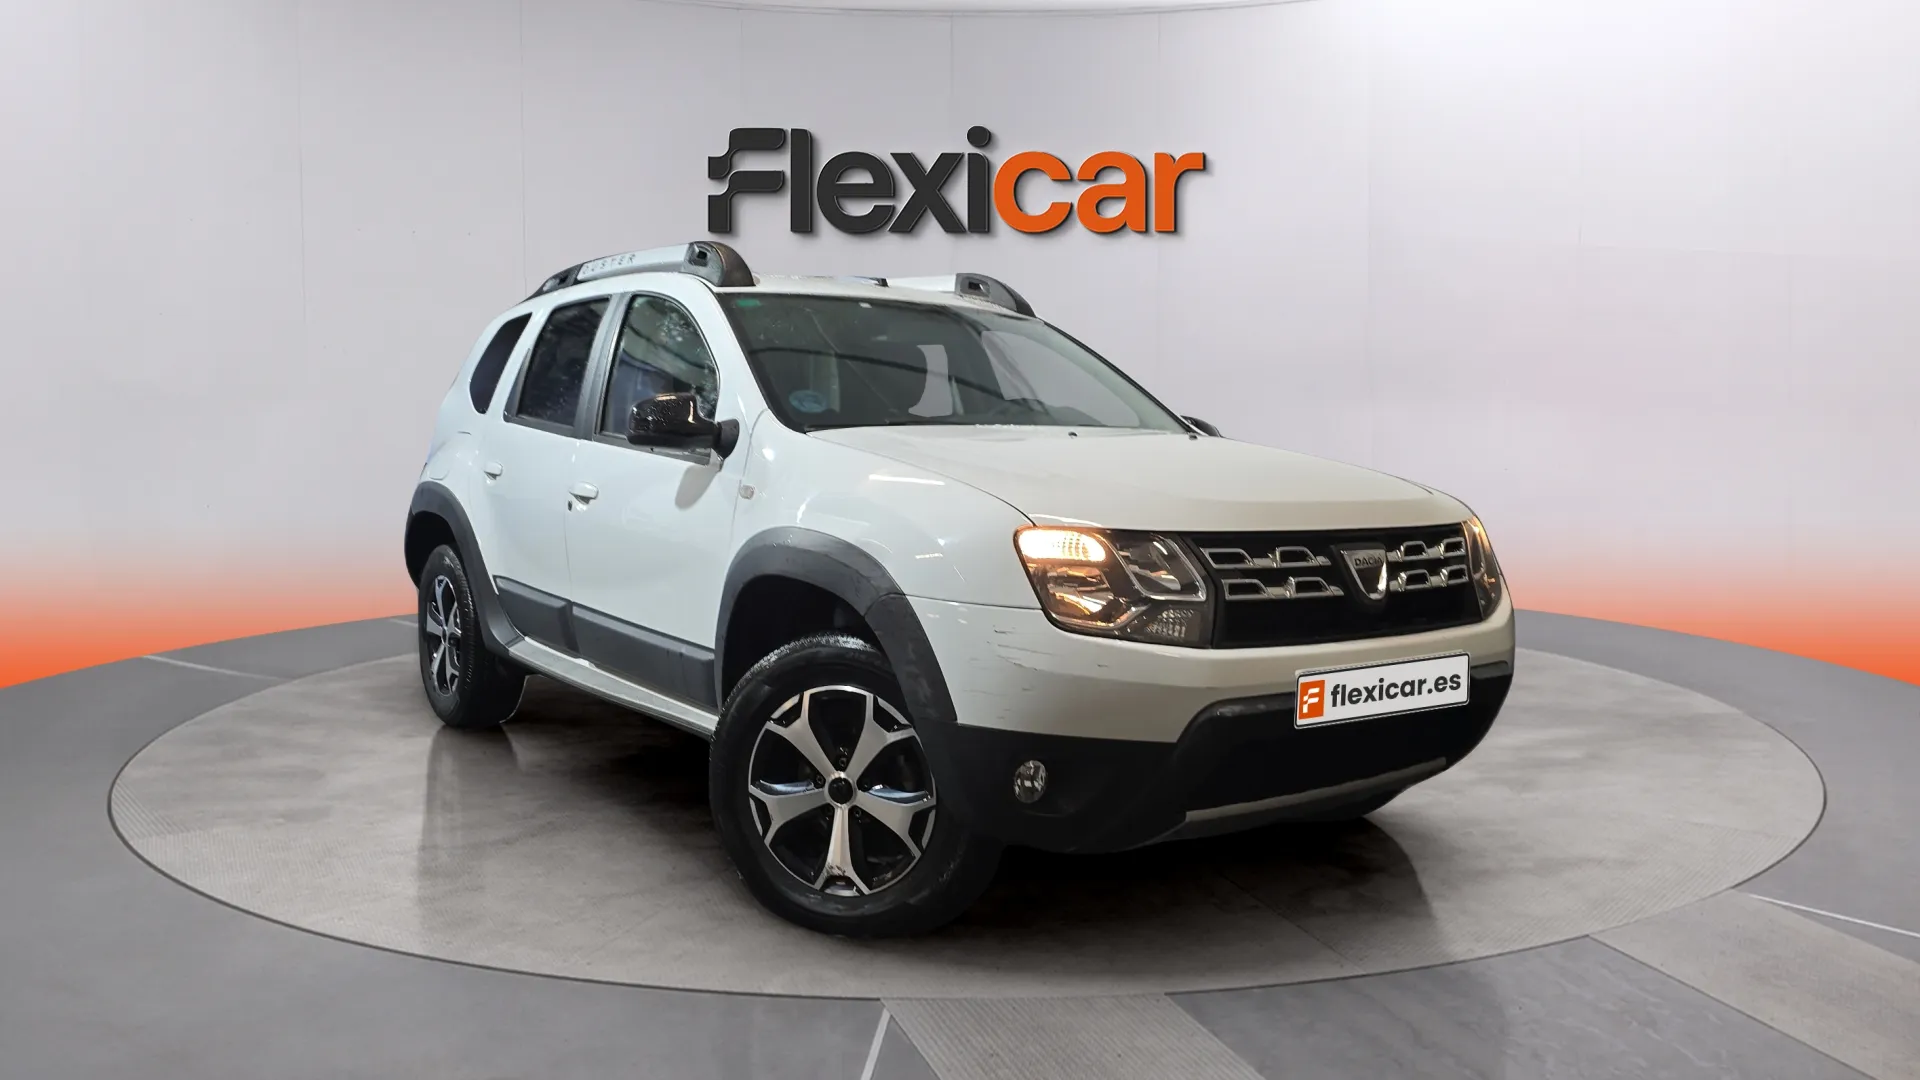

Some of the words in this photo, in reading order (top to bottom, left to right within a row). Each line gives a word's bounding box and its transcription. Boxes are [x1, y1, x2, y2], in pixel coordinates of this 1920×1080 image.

[708, 125, 1205, 233] Flexicar
[1353, 556, 1384, 567] DACIA
[1330, 673, 1462, 708] flexicar.es
